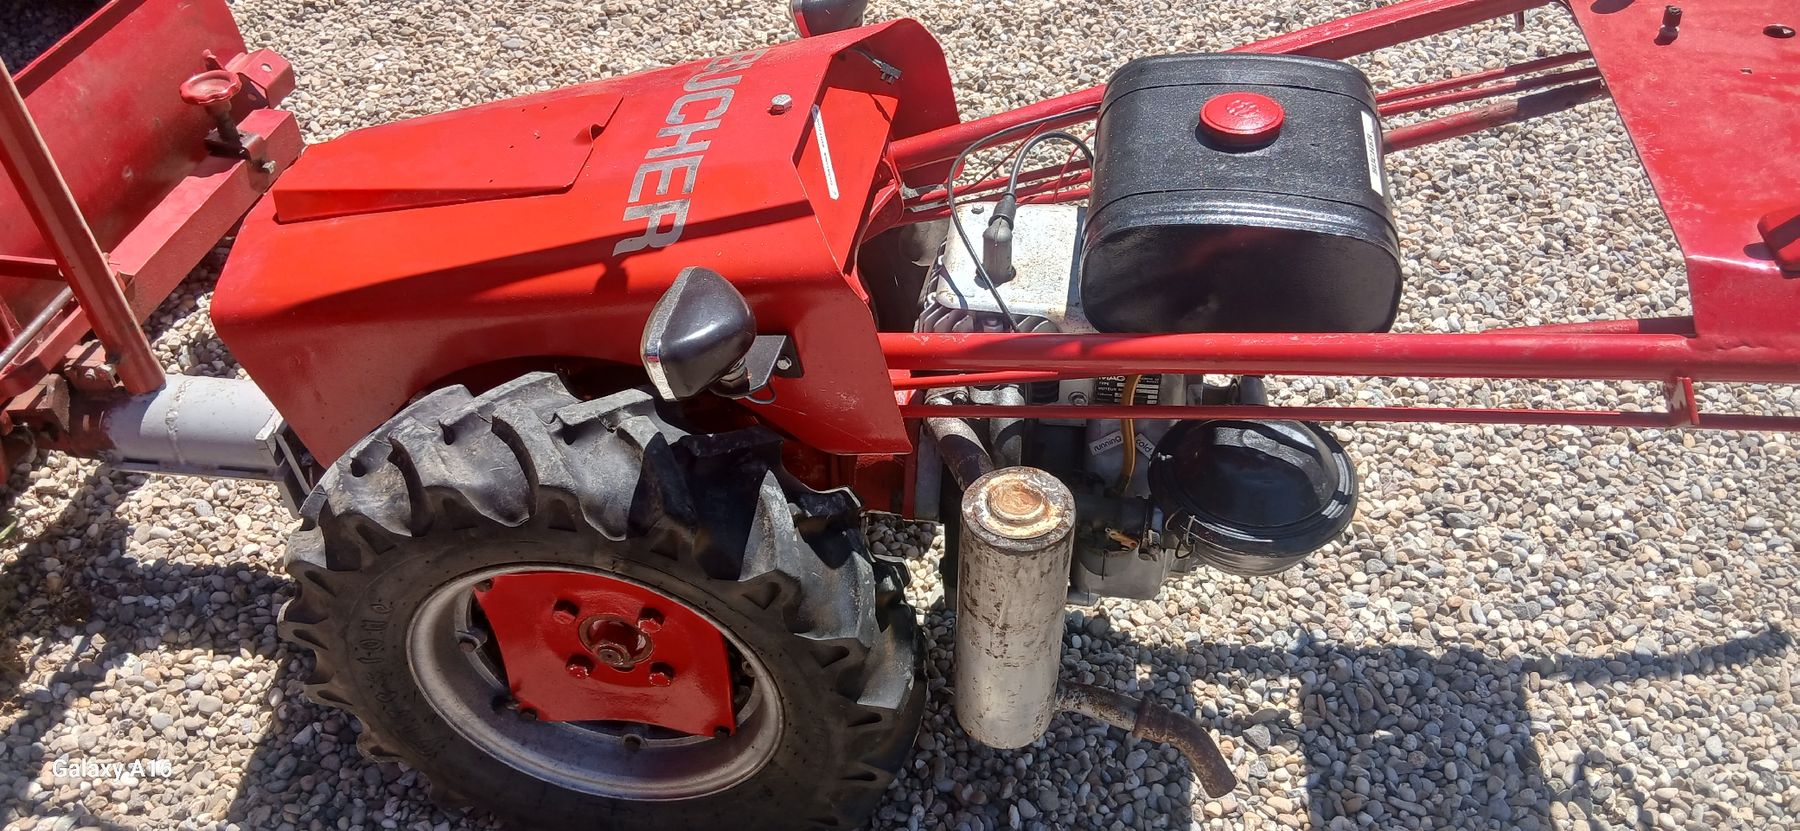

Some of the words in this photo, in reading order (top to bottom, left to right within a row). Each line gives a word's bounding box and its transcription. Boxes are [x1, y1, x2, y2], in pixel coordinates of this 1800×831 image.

[612, 47, 770, 256] BUCHER
[1094, 435, 1122, 453] running
[1135, 438, 1153, 453] cold
